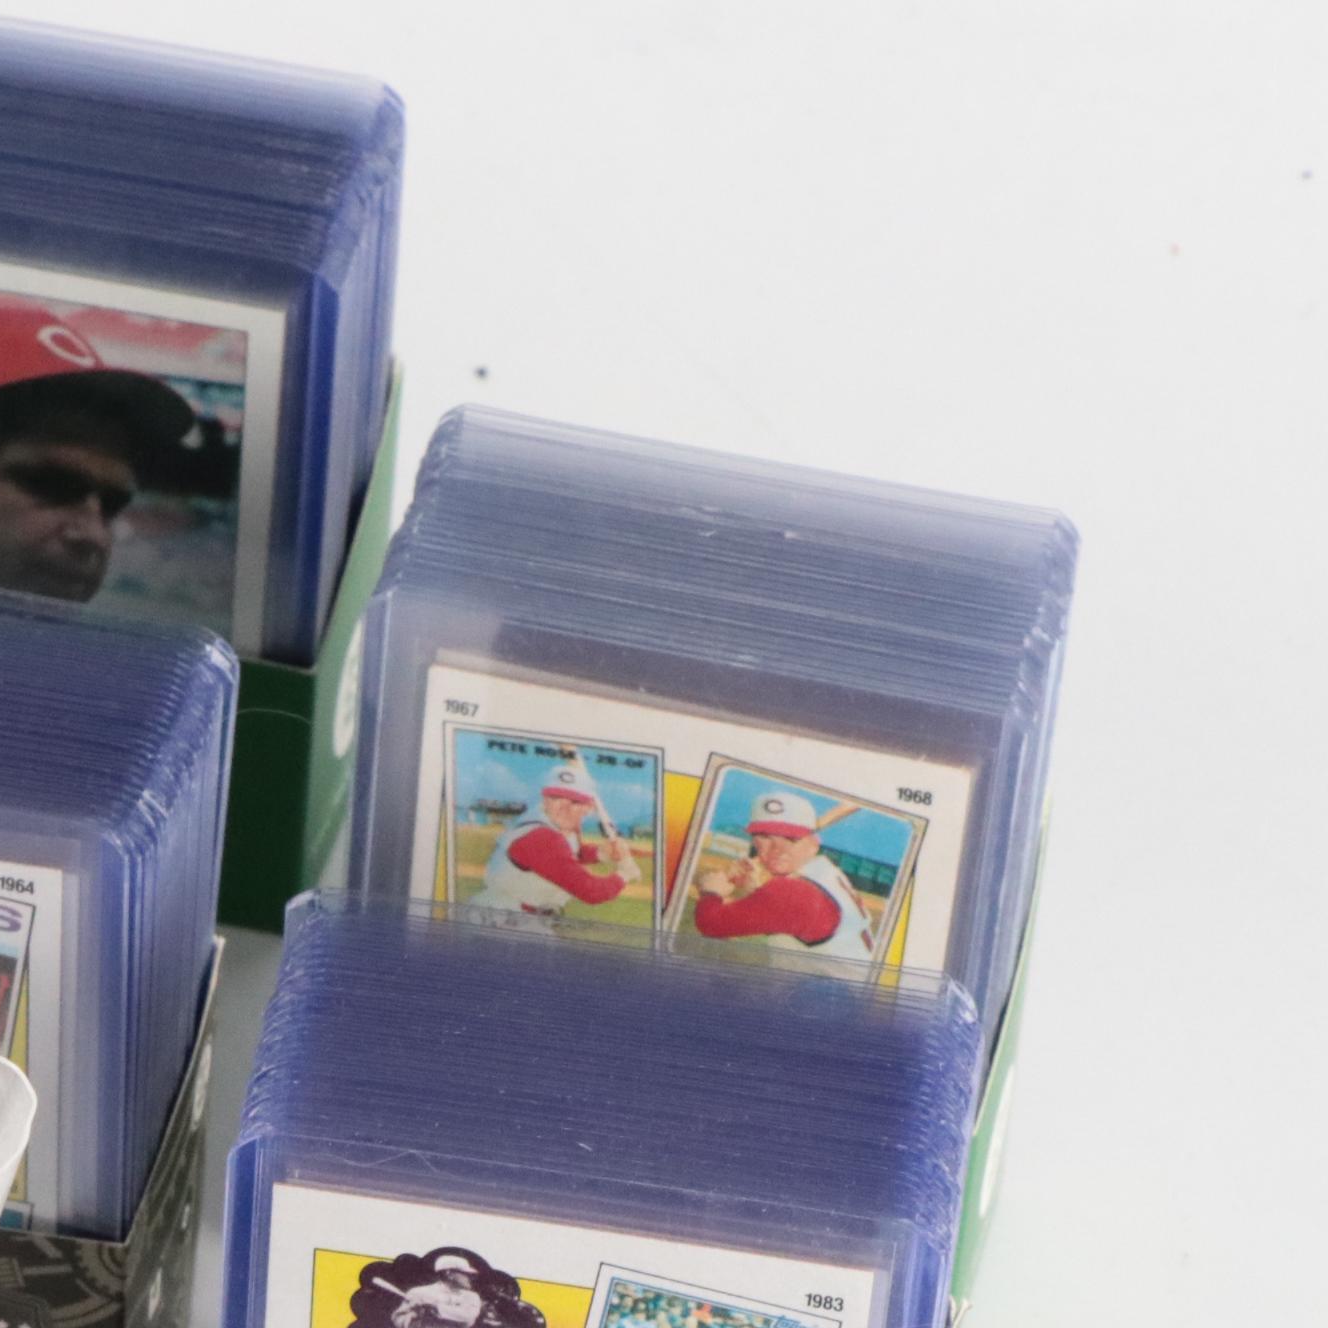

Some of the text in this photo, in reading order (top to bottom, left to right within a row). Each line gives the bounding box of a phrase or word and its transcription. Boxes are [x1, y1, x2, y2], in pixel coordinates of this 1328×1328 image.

[443, 698, 480, 717] 1967
[487, 738, 528, 754] PETE
[896, 786, 933, 806] 1968
[804, 1292, 844, 1312] 1983
